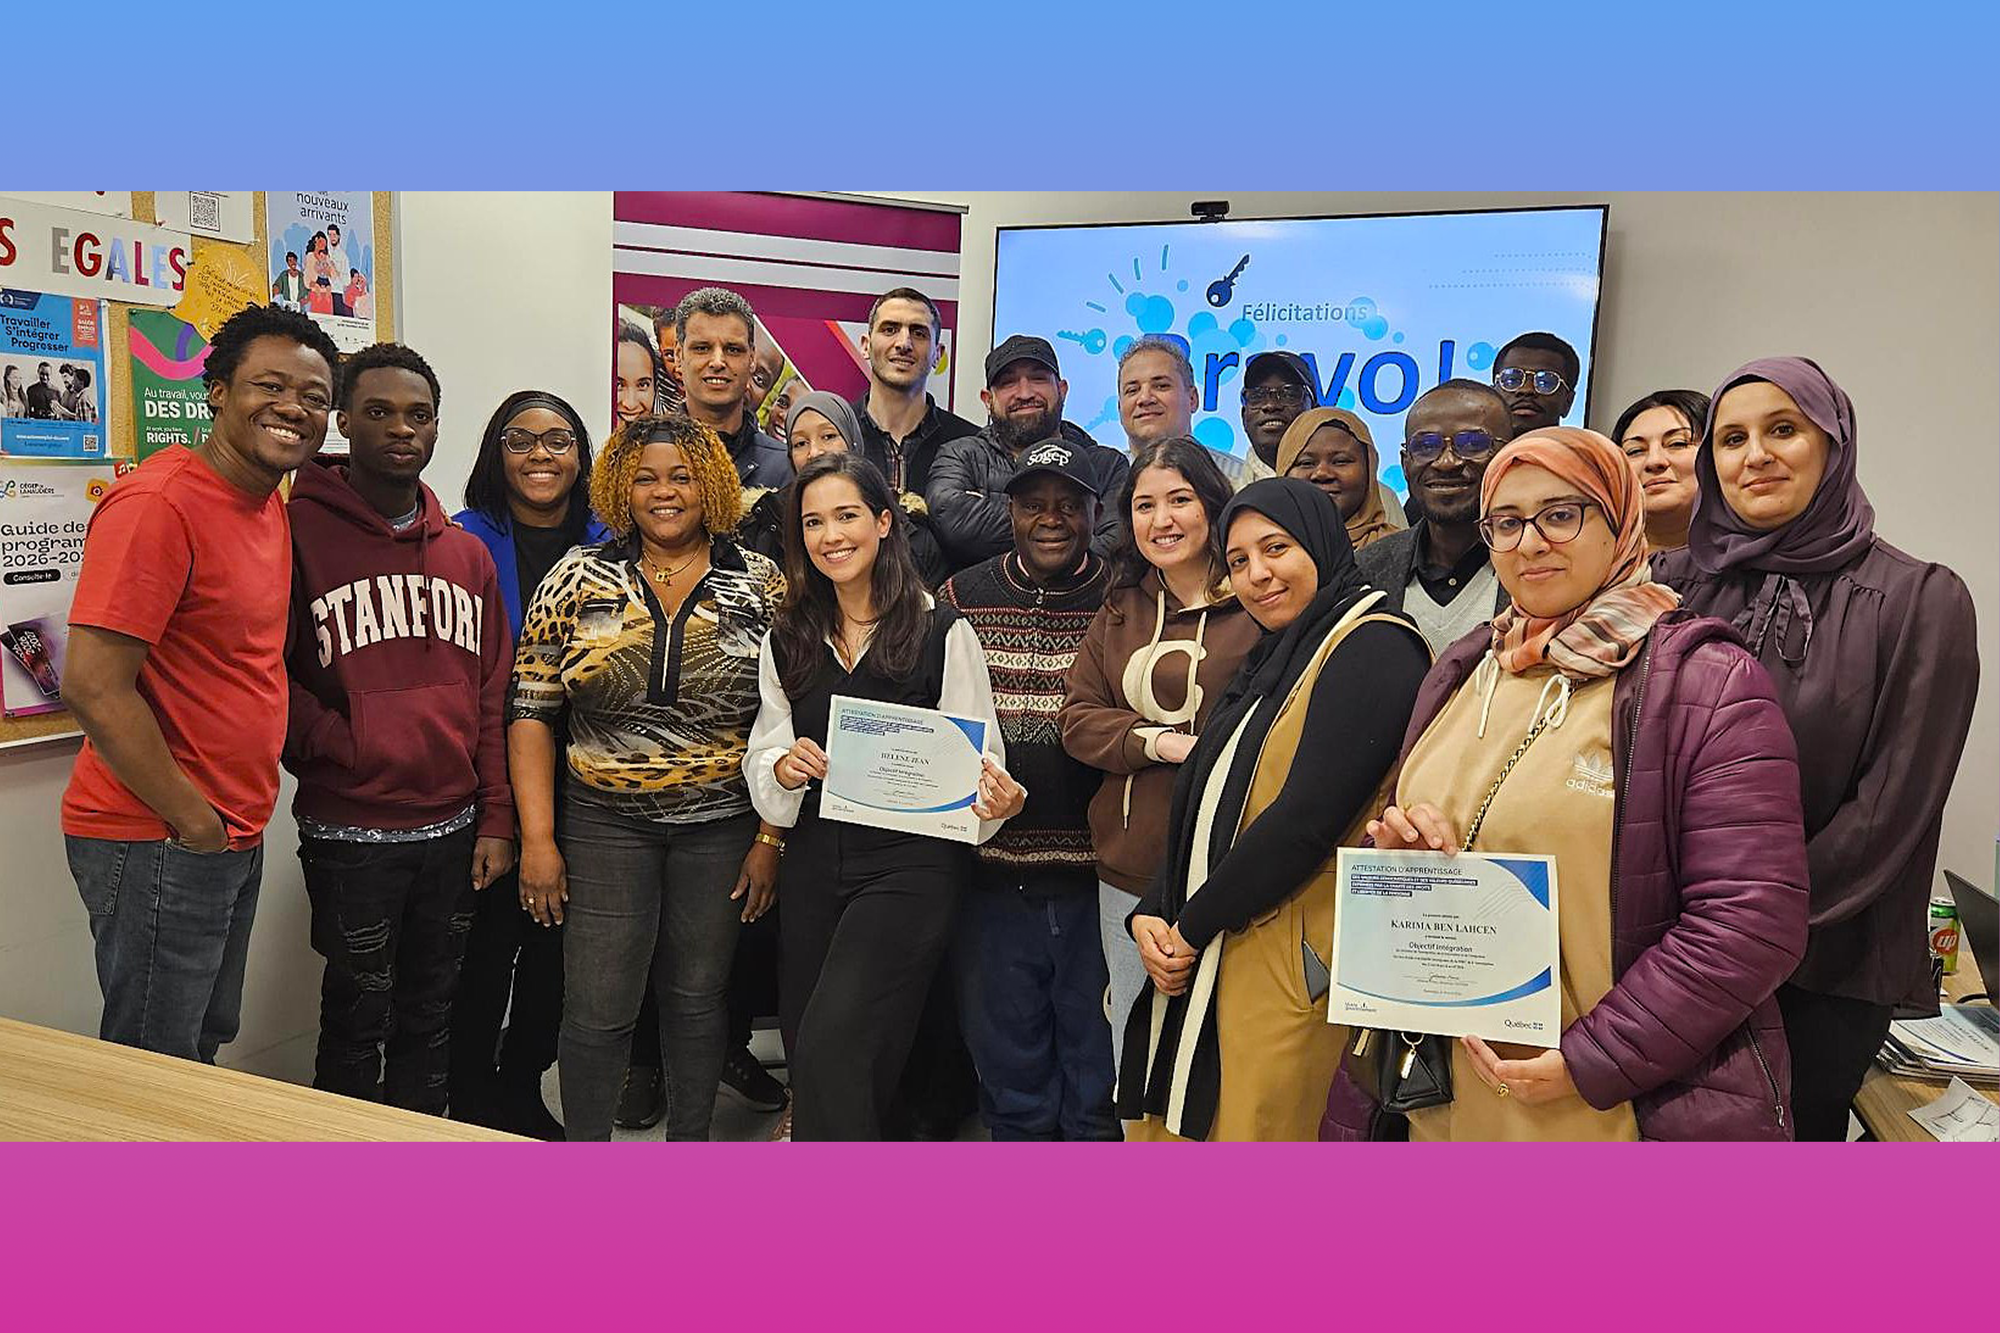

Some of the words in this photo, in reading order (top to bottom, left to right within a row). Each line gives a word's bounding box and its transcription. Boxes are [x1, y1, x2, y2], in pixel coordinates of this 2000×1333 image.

[297, 191, 349, 213] nouveaux
[300, 206, 347, 225] arrivants
[52, 226, 187, 291] EGALES
[1242, 302, 1367, 321] Félicitations
[0, 314, 51, 330] Travailler
[5, 326, 59, 342] S'intégrer
[11, 337, 69, 352] Progresser
[1143, 333, 1456, 414] rvo!
[144, 387, 157, 398] Au
[159, 388, 189, 400] travail,
[144, 400, 181, 418] DES
[184, 402, 214, 419] DR
[146, 432, 191, 444] RIGHTS.
[1, 521, 59, 536] Guide
[1351, 864, 1398, 873] ATTESTATION
[1398, 866, 1463, 876] D'APPRENTISSAGE
[1391, 919, 1432, 931] KARIMA
[1433, 922, 1454, 932] BEN
[1456, 923, 1498, 935] LAHCEN
[1409, 941, 1436, 953] Objectif
